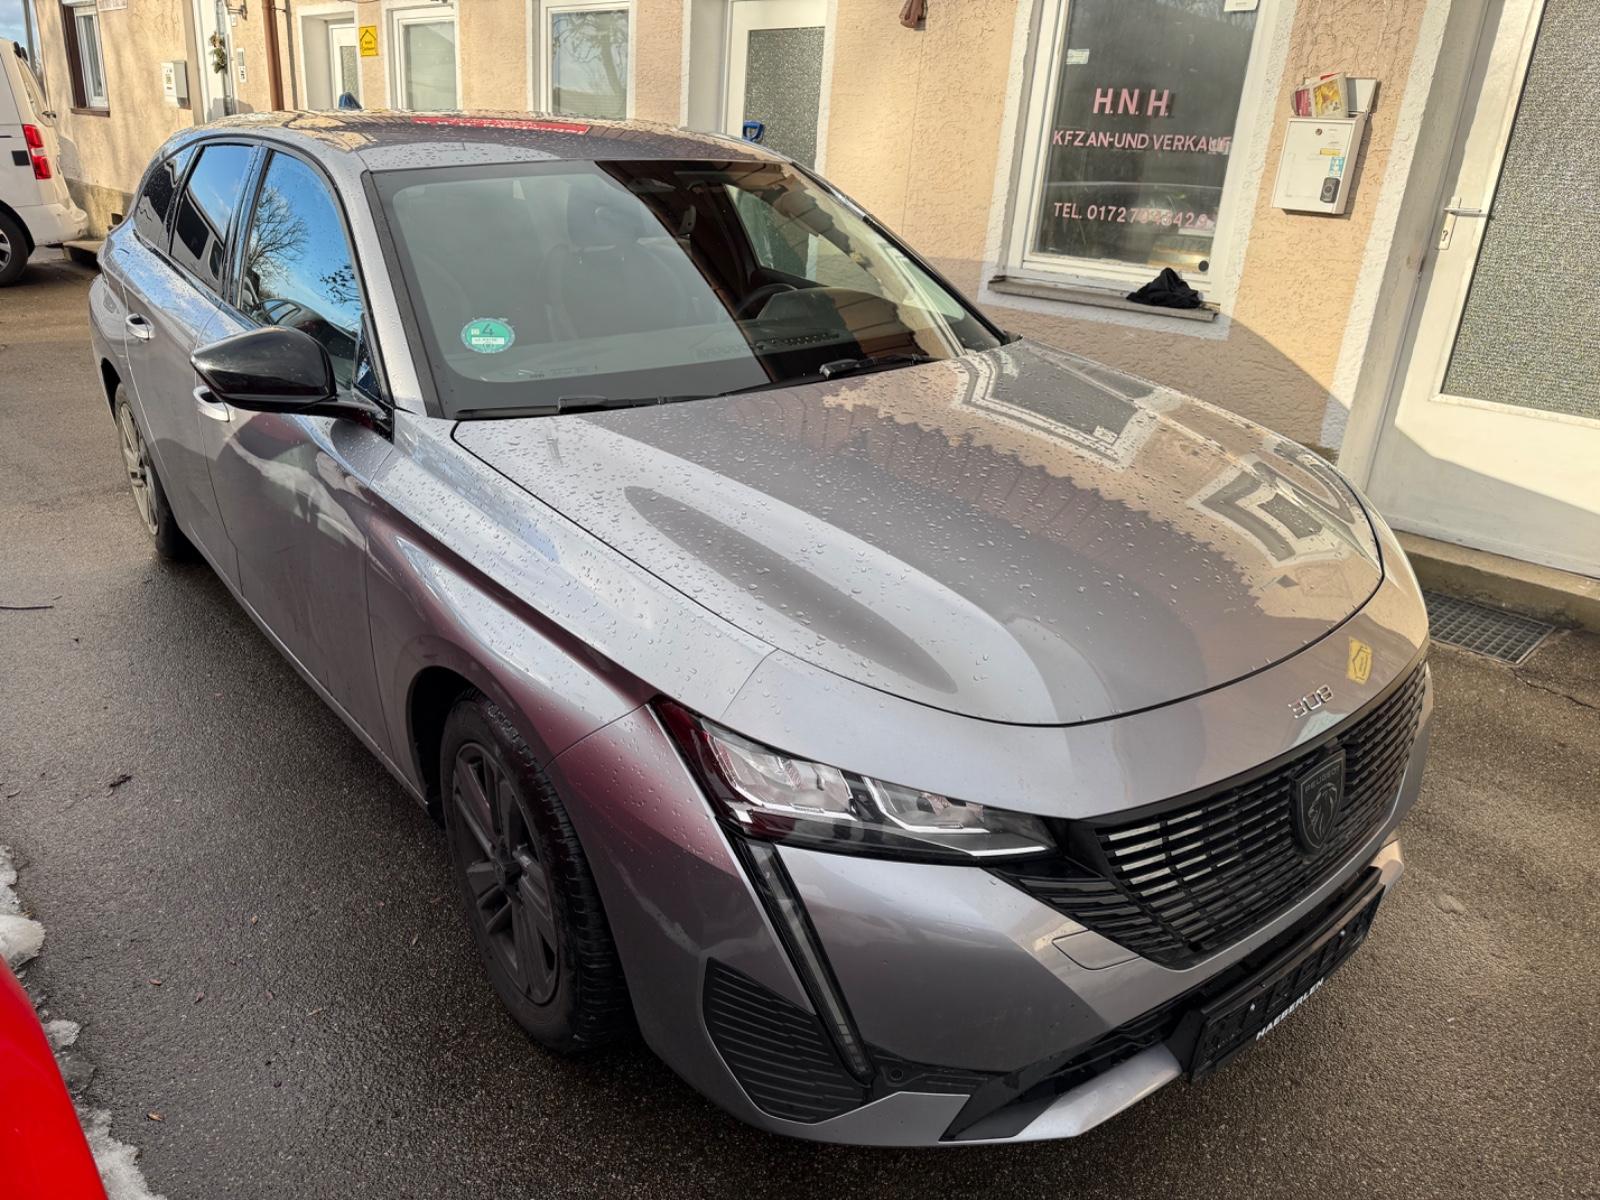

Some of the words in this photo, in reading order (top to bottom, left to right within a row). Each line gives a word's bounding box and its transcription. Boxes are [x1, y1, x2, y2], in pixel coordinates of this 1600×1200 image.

[1052, 130, 1086, 147] KFZ
[1053, 202, 1083, 219] TEL.
[481, 323, 495, 336] 4
[1287, 684, 1334, 719] 308
[1304, 764, 1341, 794] PEUGEOT
